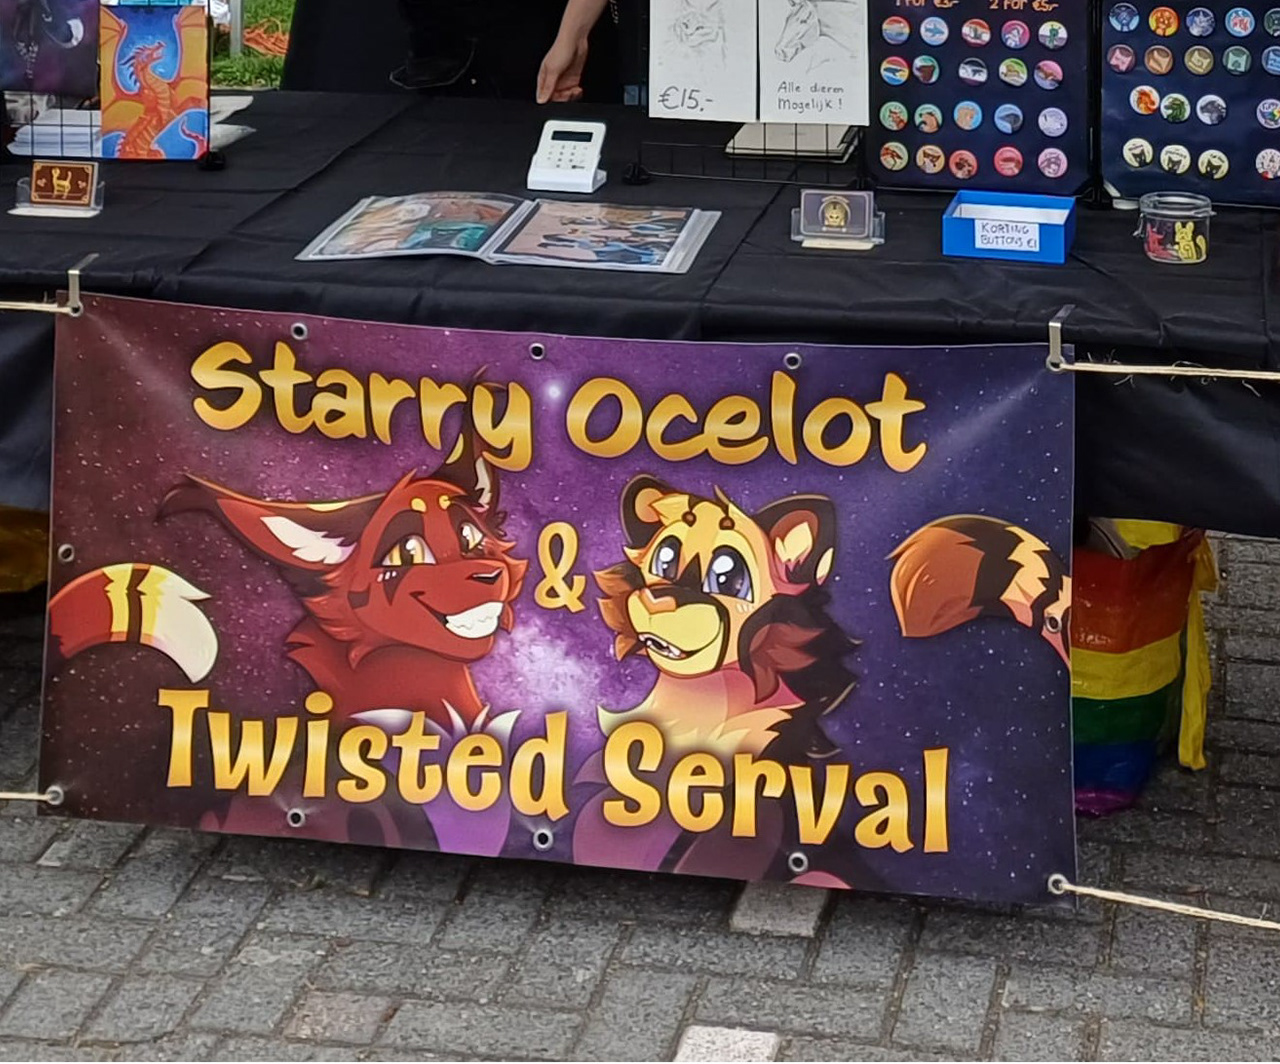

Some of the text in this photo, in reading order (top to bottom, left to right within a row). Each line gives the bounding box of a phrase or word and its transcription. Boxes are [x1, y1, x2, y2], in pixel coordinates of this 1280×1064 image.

[777, 80, 801, 94] Alle
[981, 221, 1030, 235] KORTING
[189, 340, 928, 474] Starry Ocelot
[534, 522, 587, 615] &
[157, 688, 950, 855] Twisted Serval
